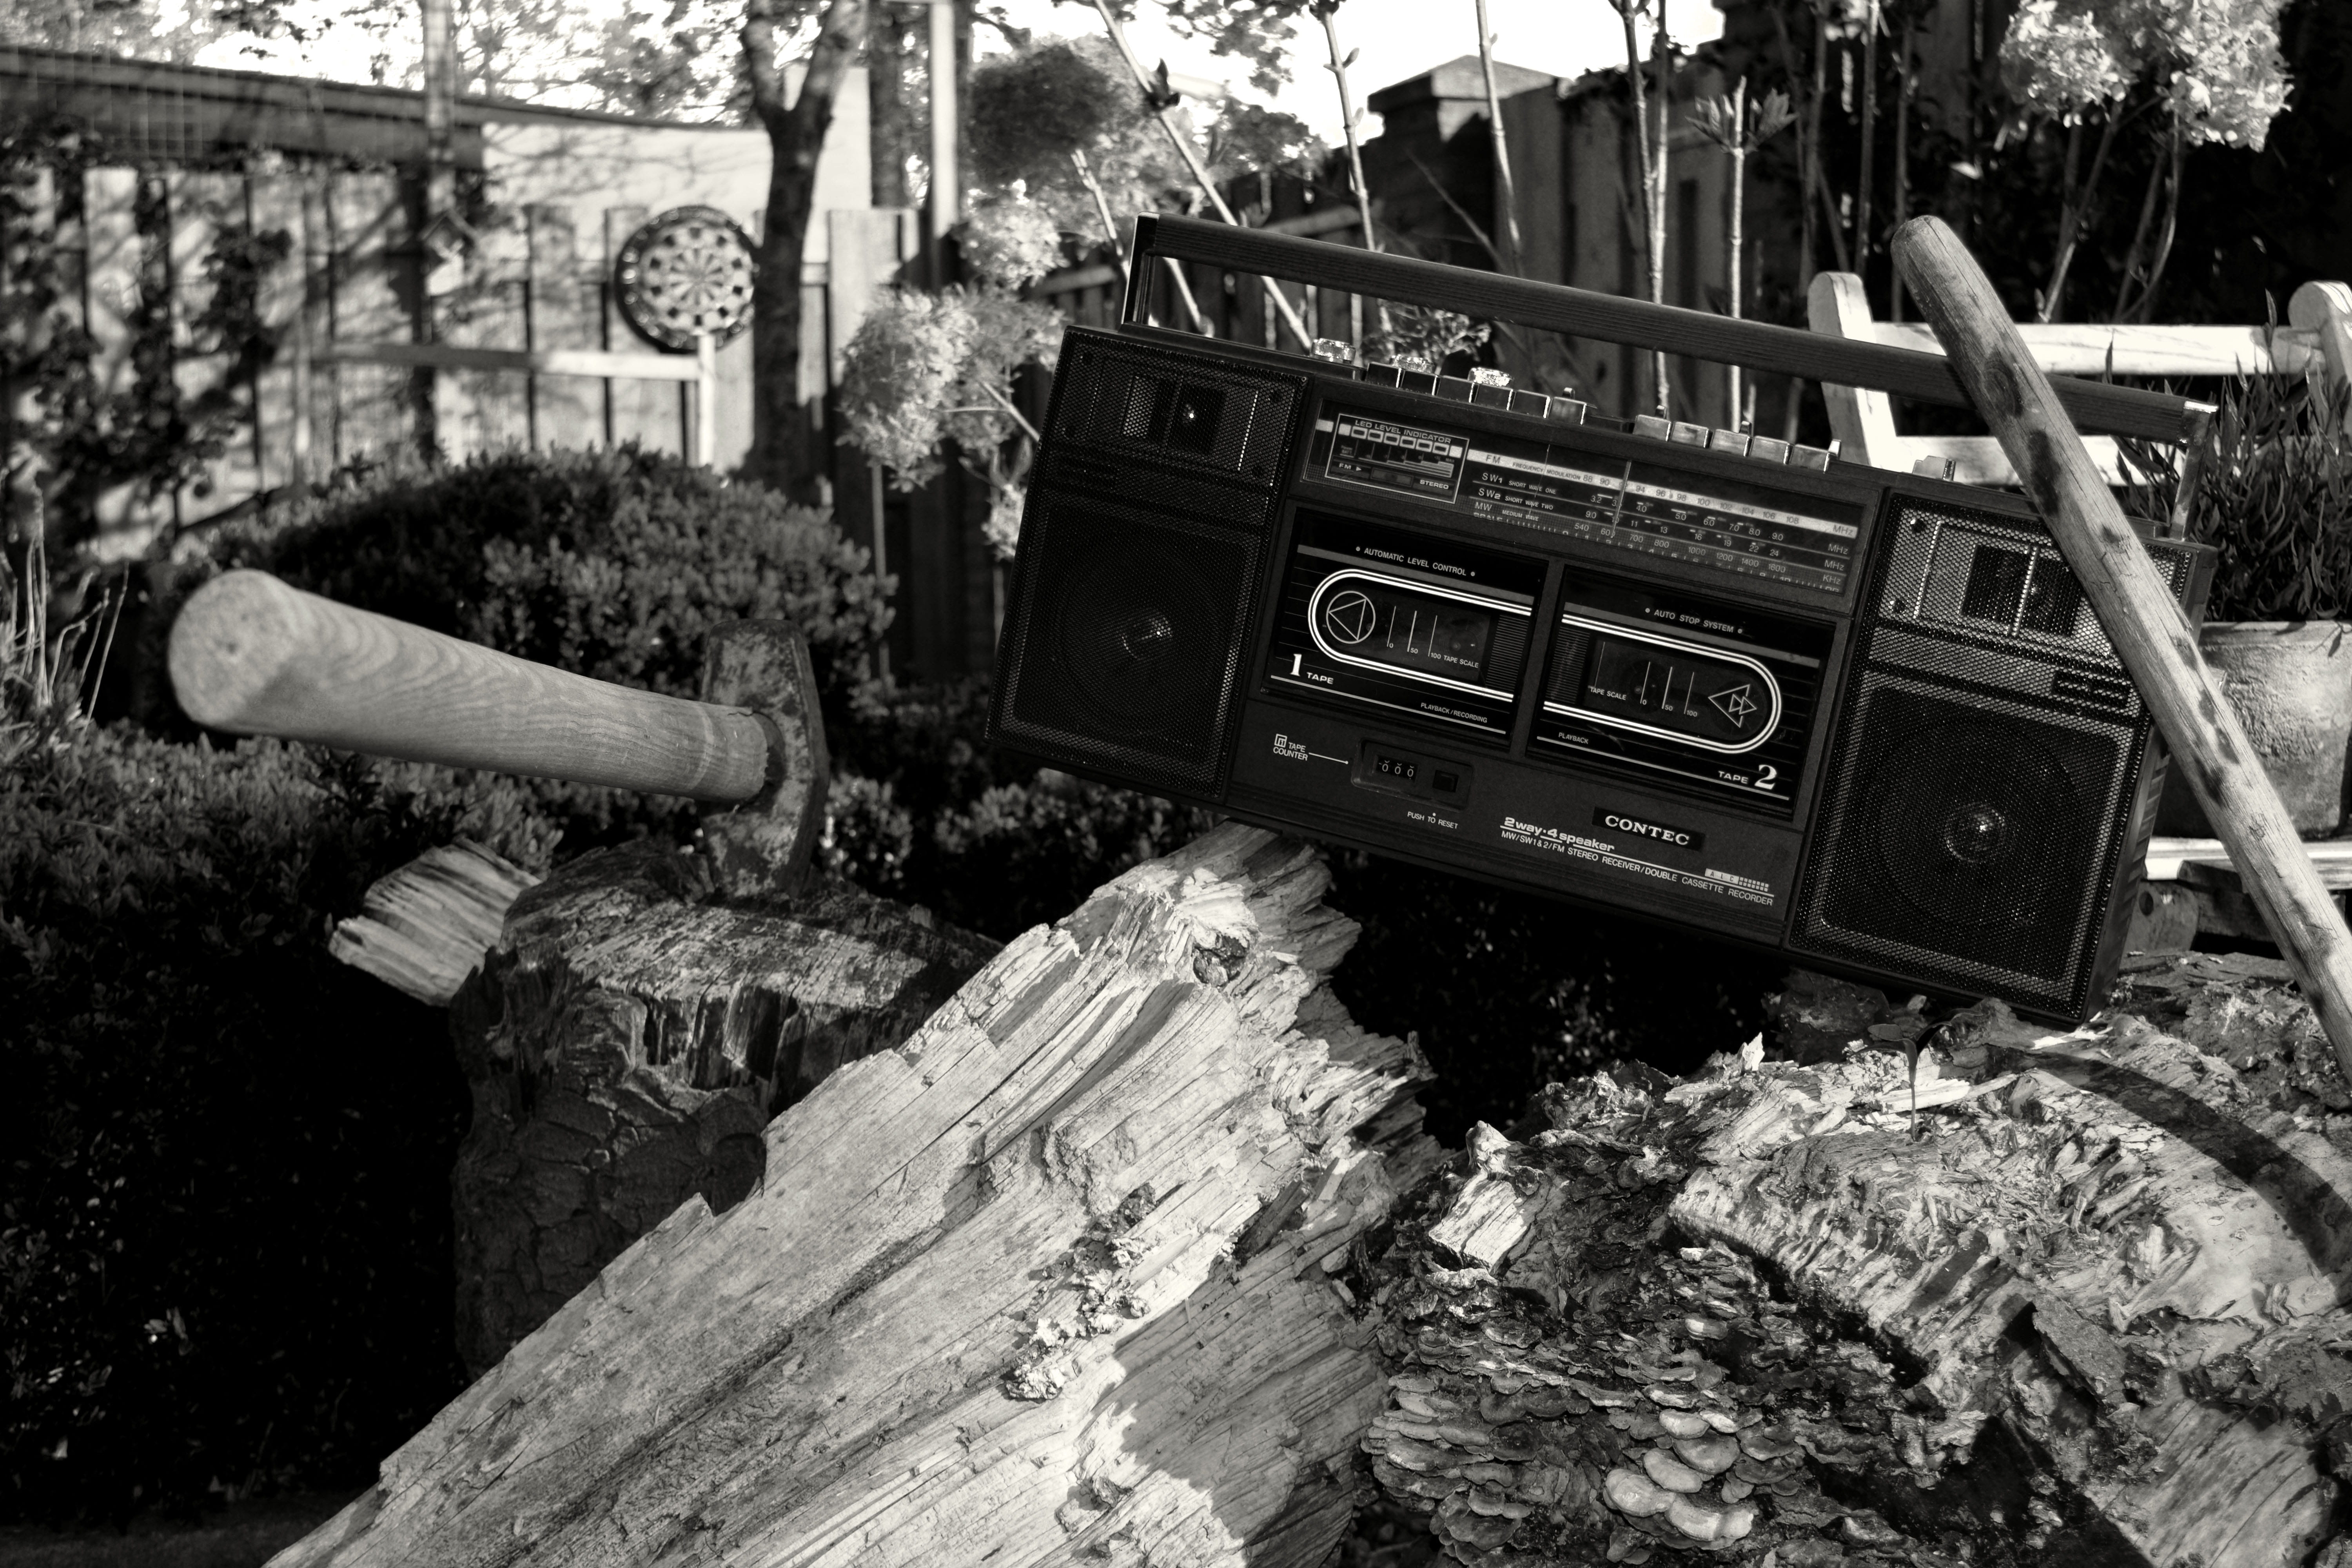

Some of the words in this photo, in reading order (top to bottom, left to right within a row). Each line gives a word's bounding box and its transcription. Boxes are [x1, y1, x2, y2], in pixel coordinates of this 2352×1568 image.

[1355, 420, 1372, 428] LED
[1375, 424, 1401, 434] LEVEL
[1403, 429, 1452, 444] INDICATOR
[1419, 479, 1449, 490] STEREO
[1486, 454, 1501, 464] FM
[1512, 462, 1544, 473] FREQUENCY
[1547, 469, 1581, 481] MODULATION
[1583, 475, 1593, 483] 88
[1599, 478, 1610, 486] 90
[1655, 489, 1666, 497] 96
[1697, 497, 1710, 506] 100
[1720, 502, 1732, 510] 102
[1742, 507, 1754, 515] 104
[1763, 511, 1775, 519] 106
[1786, 515, 1799, 524] 108
[1832, 524, 1853, 536] MHz
[1481, 472, 1503, 483] SW1
[1508, 480, 1526, 490] SHORT
[1529, 483, 1543, 492] WAVE
[1590, 495, 1602, 503] 3.2
[1636, 505, 1647, 513] 4.0
[1675, 513, 1686, 521] 5.0
[1703, 518, 1715, 526] 6.0
[1729, 523, 1739, 532] 7.0
[1748, 528, 1760, 536] 8.0
[1772, 532, 1784, 541] 9.0
[1828, 543, 1848, 555] MHz
[1478, 488, 1501, 500] SW2
[1504, 496, 1523, 504] SHORT
[1585, 511, 1597, 519] 9.0
[1748, 545, 1759, 553] 22
[1824, 559, 1845, 571] MHz
[1474, 501, 1493, 512] MW
[1501, 510, 1523, 518] MEDIUM
[1525, 513, 1539, 522] WAVE
[1574, 522, 1589, 532] 540
[1629, 534, 1644, 543] 700
[1654, 539, 1670, 548] 800
[1688, 546, 1706, 556] 1000
[1716, 552, 1733, 562] 1200
[1742, 558, 1759, 568] 1400
[1768, 563, 1786, 573] 1600
[1823, 574, 1841, 585] KHz
[1364, 547, 1405, 563] AUTOMATIC
[1407, 557, 1430, 568] LEVEL
[1432, 562, 1467, 577] CONTROL
[1654, 609, 1675, 620] AUTO
[1679, 614, 1700, 625] STOP
[1703, 619, 1734, 634] SYSTEM
[1289, 653, 1303, 677] 1
[1306, 671, 1334, 685] TAPE
[1443, 655, 1458, 664] TAPE
[1459, 659, 1479, 668] SCALE
[1590, 686, 1604, 696] TAPE
[1607, 690, 1627, 701] SCALE
[1421, 702, 1488, 724] PLAYBACK/RECORDING
[1288, 742, 1306, 753] TAPE
[1558, 732, 1589, 745] PLAYBACK
[1273, 746, 1308, 761] COUNTER
[1718, 769, 1749, 785] TAPE
[1754, 763, 1778, 791] 2
[1407, 811, 1425, 822] PUSH
[1427, 815, 1436, 824] TO
[1438, 818, 1458, 829] RESET
[1604, 815, 1691, 846] CONTEC
[1567, 847, 1599, 862] STEREO
[1602, 857, 1677, 882] RECEIVER/DOUBLE
[1681, 877, 1724, 894] CASSETTE
[1728, 888, 1773, 906] RECORDER
